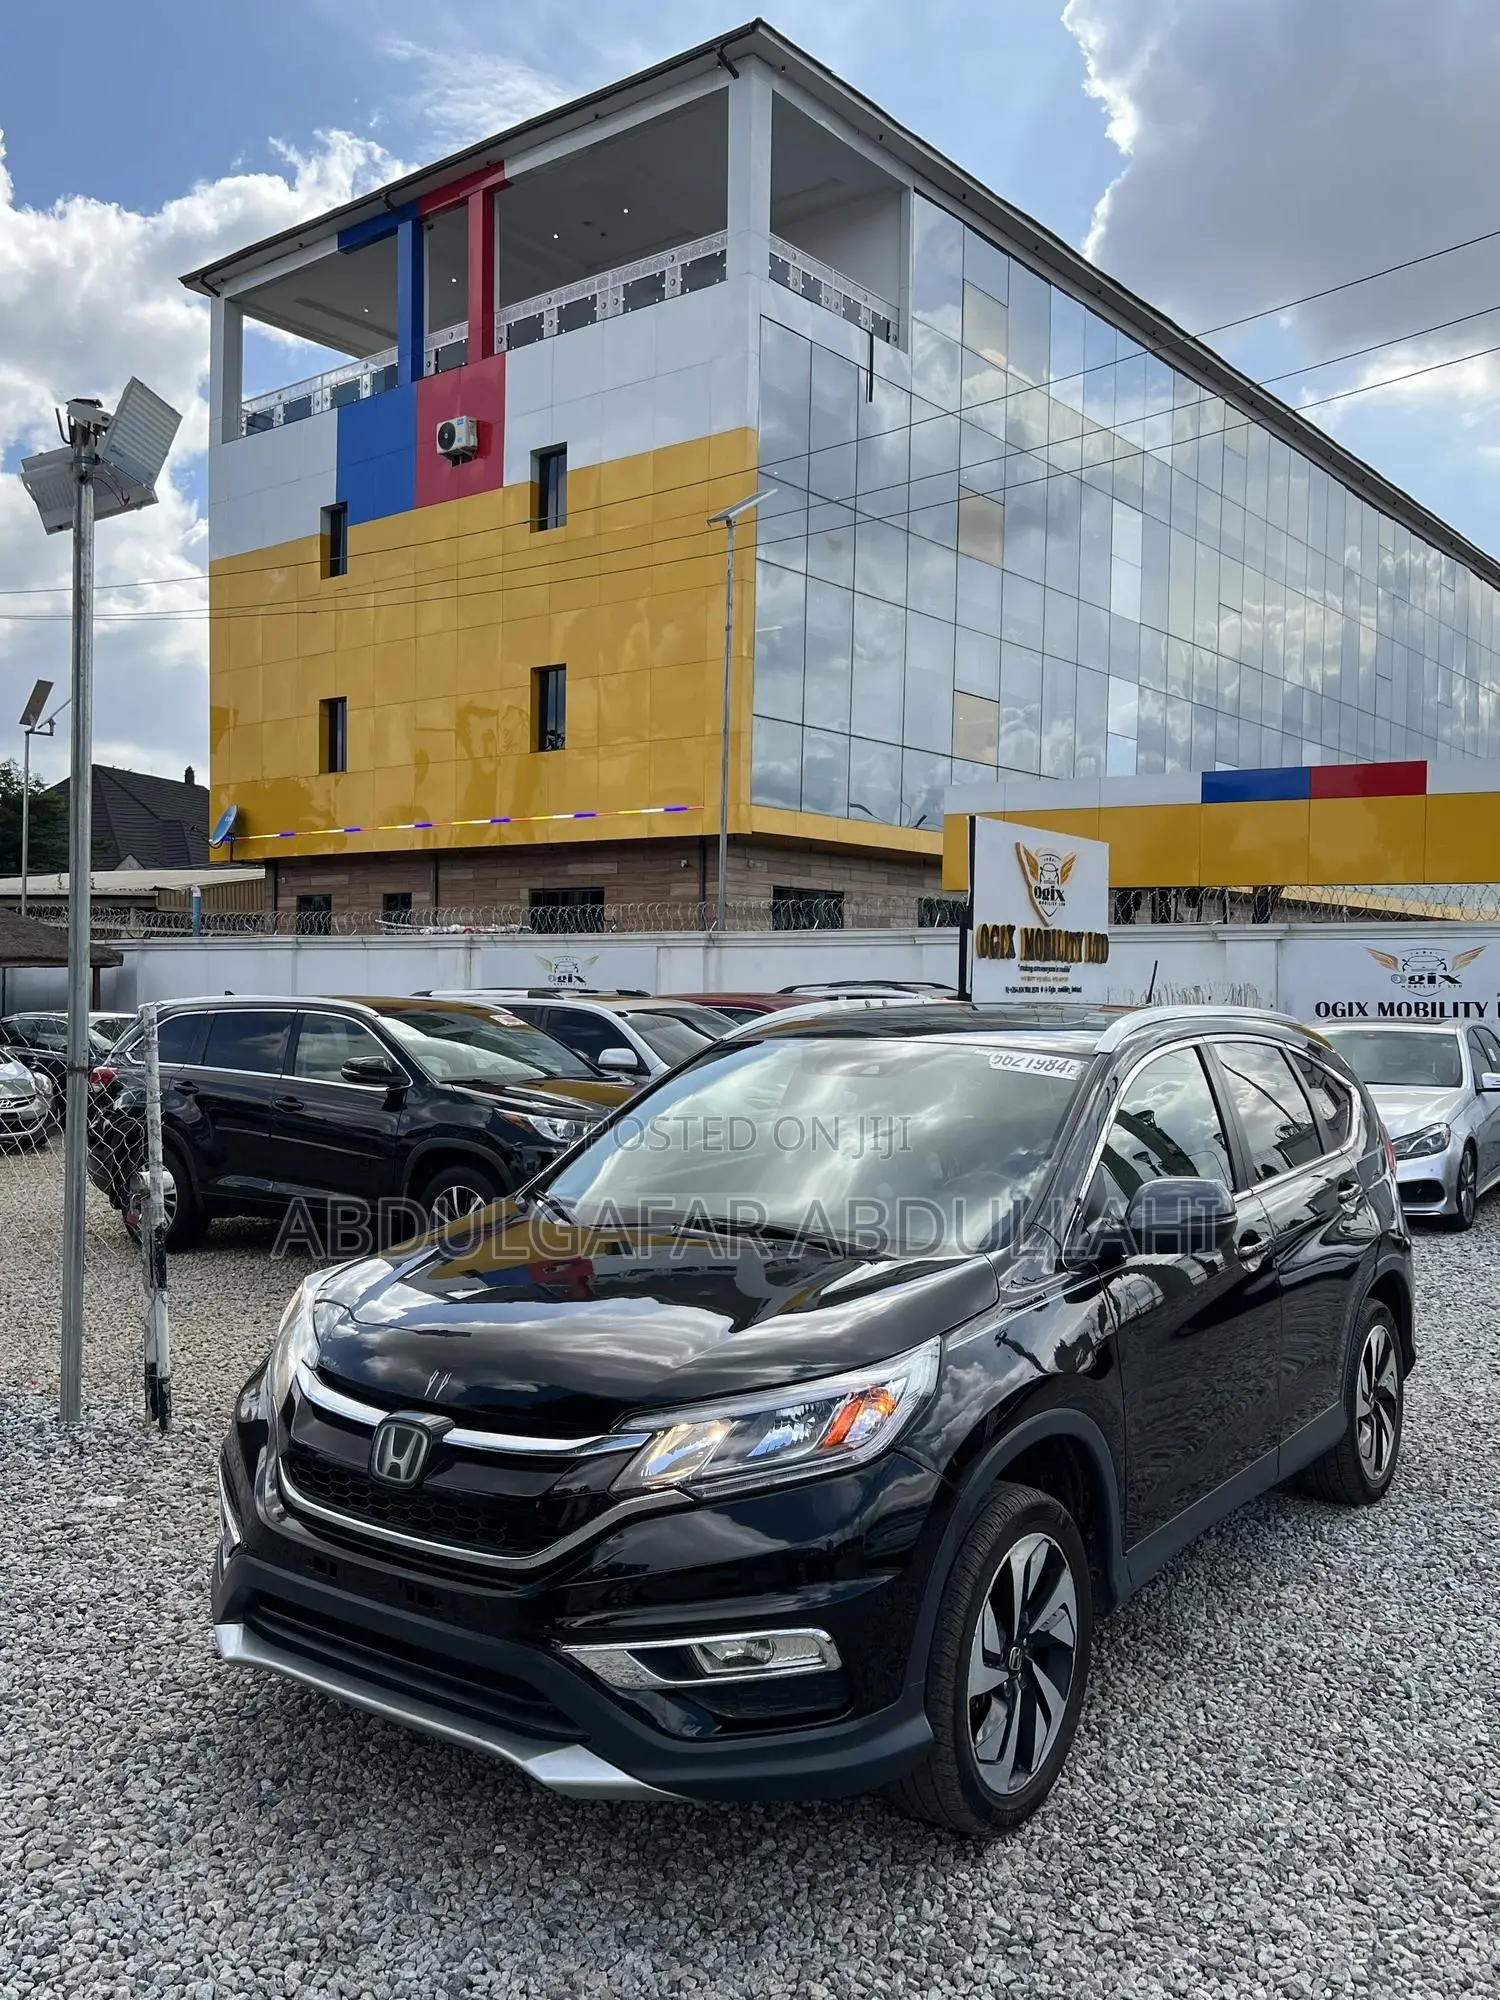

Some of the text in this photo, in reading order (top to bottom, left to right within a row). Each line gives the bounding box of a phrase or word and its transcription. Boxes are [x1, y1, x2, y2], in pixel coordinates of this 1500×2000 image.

[976, 924, 1016, 959] OGIX
[1315, 1001, 1369, 1018] OGIX
[1377, 1001, 1488, 1018] MOBILITY
